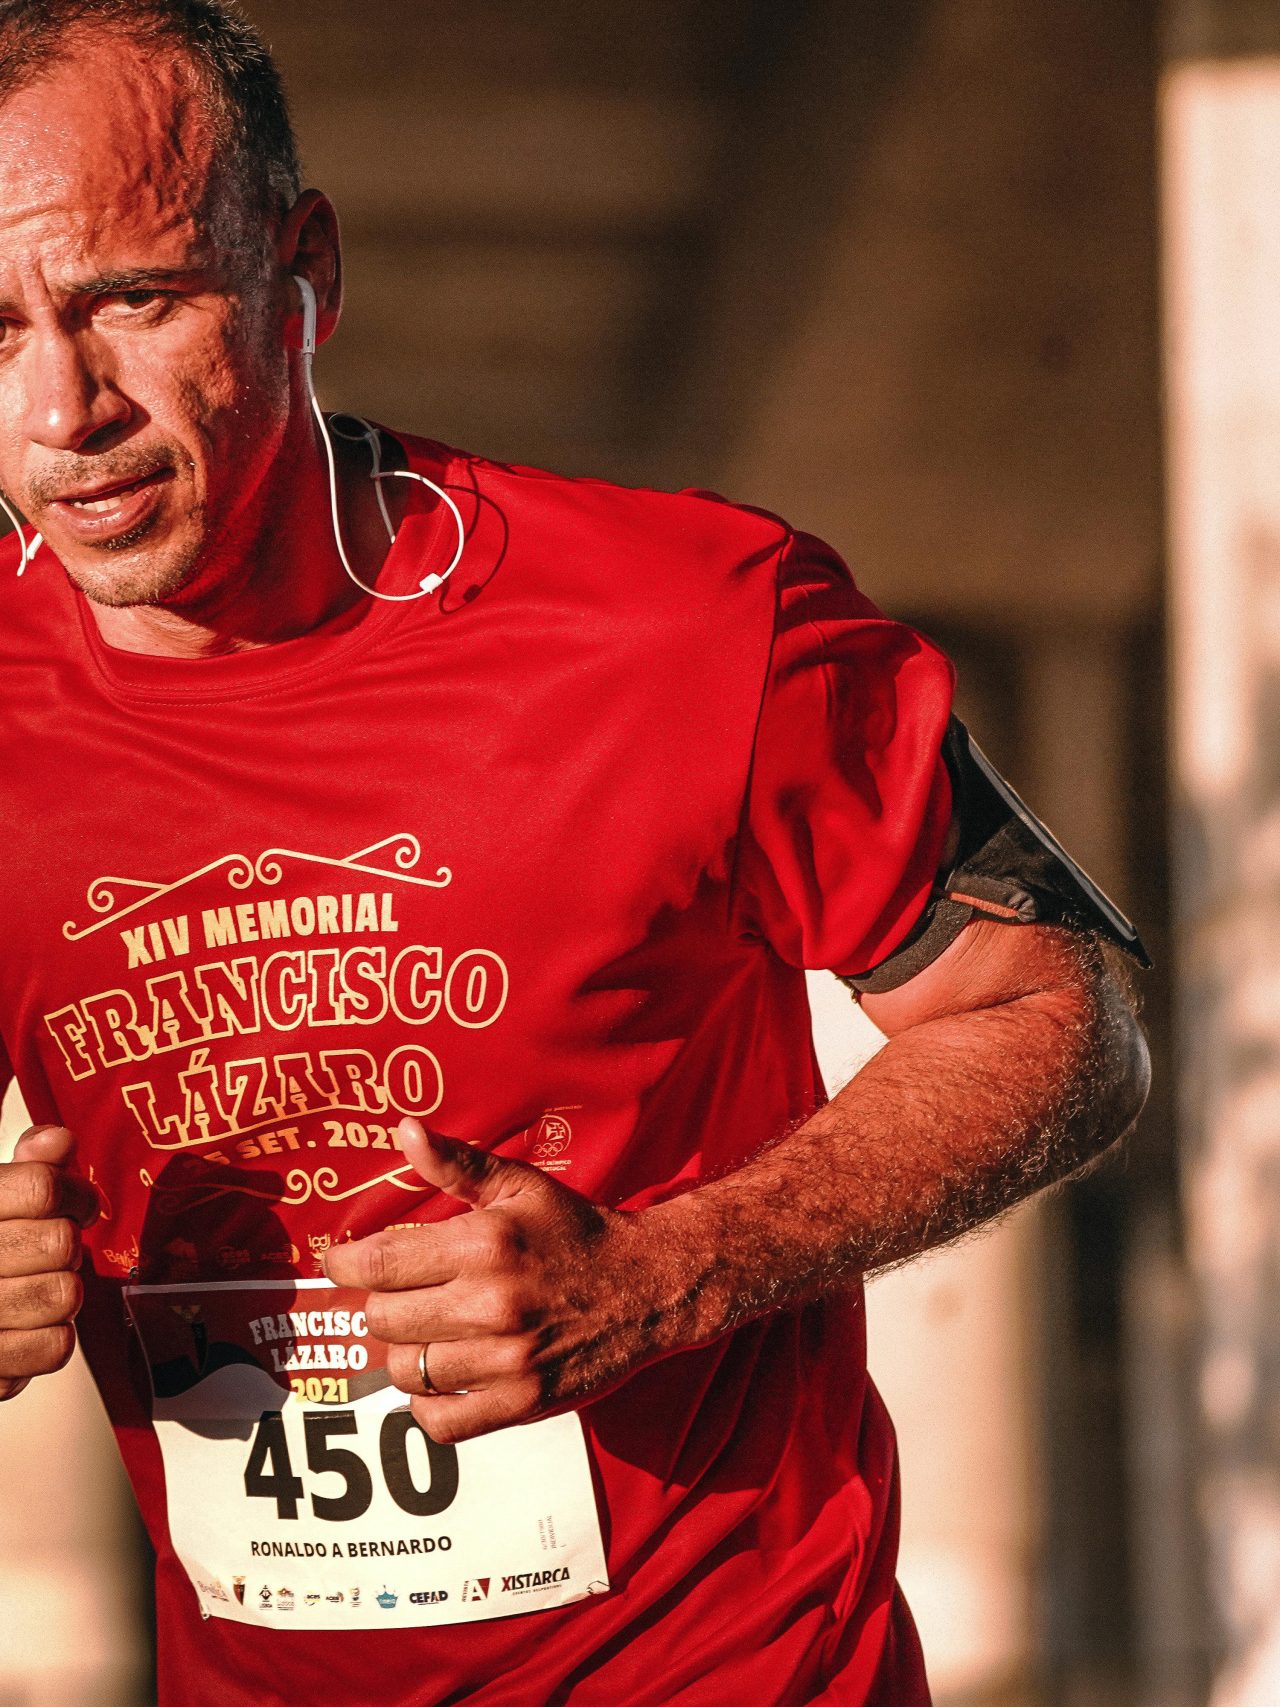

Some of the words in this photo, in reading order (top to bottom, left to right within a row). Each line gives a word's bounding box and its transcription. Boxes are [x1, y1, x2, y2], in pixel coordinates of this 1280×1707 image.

[120, 914, 191, 970] XIV
[201, 892, 399, 949] MEMORIAL
[44, 945, 509, 1082] FRANCISCO
[122, 1044, 444, 1150] LÁZARO
[248, 1311, 369, 1345] FRANCISC
[271, 1340, 368, 1372] LÁZARO
[290, 1377, 349, 1403] 2021
[243, 1410, 460, 1522] 450
[250, 1541, 328, 1557] RONALDO
[332, 1543, 344, 1558] A
[347, 1535, 453, 1557] BERNARDO
[501, 1567, 571, 1592] XISTARCA
[409, 1590, 449, 1604] CEFAD
